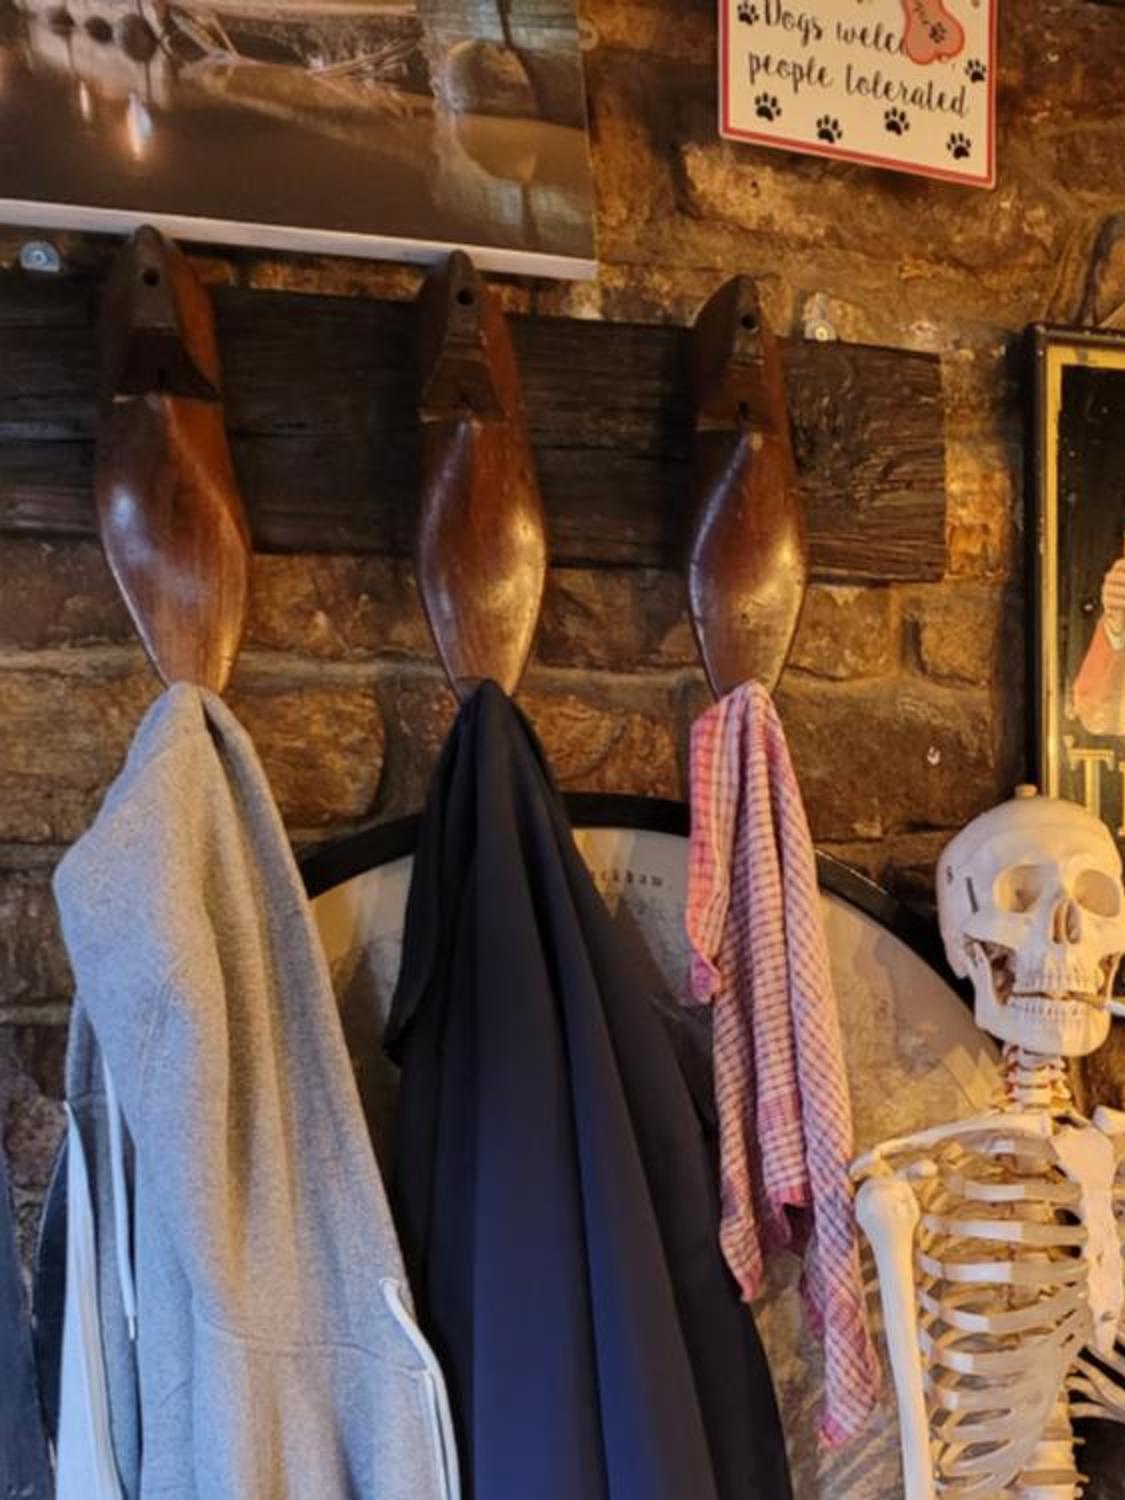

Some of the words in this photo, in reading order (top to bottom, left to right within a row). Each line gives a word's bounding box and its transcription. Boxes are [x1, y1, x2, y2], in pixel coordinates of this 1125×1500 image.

[763, 0, 825, 47] Dogs
[836, 21, 907, 57] welc
[748, 51, 834, 94] people
[845, 63, 970, 118] tolerated
